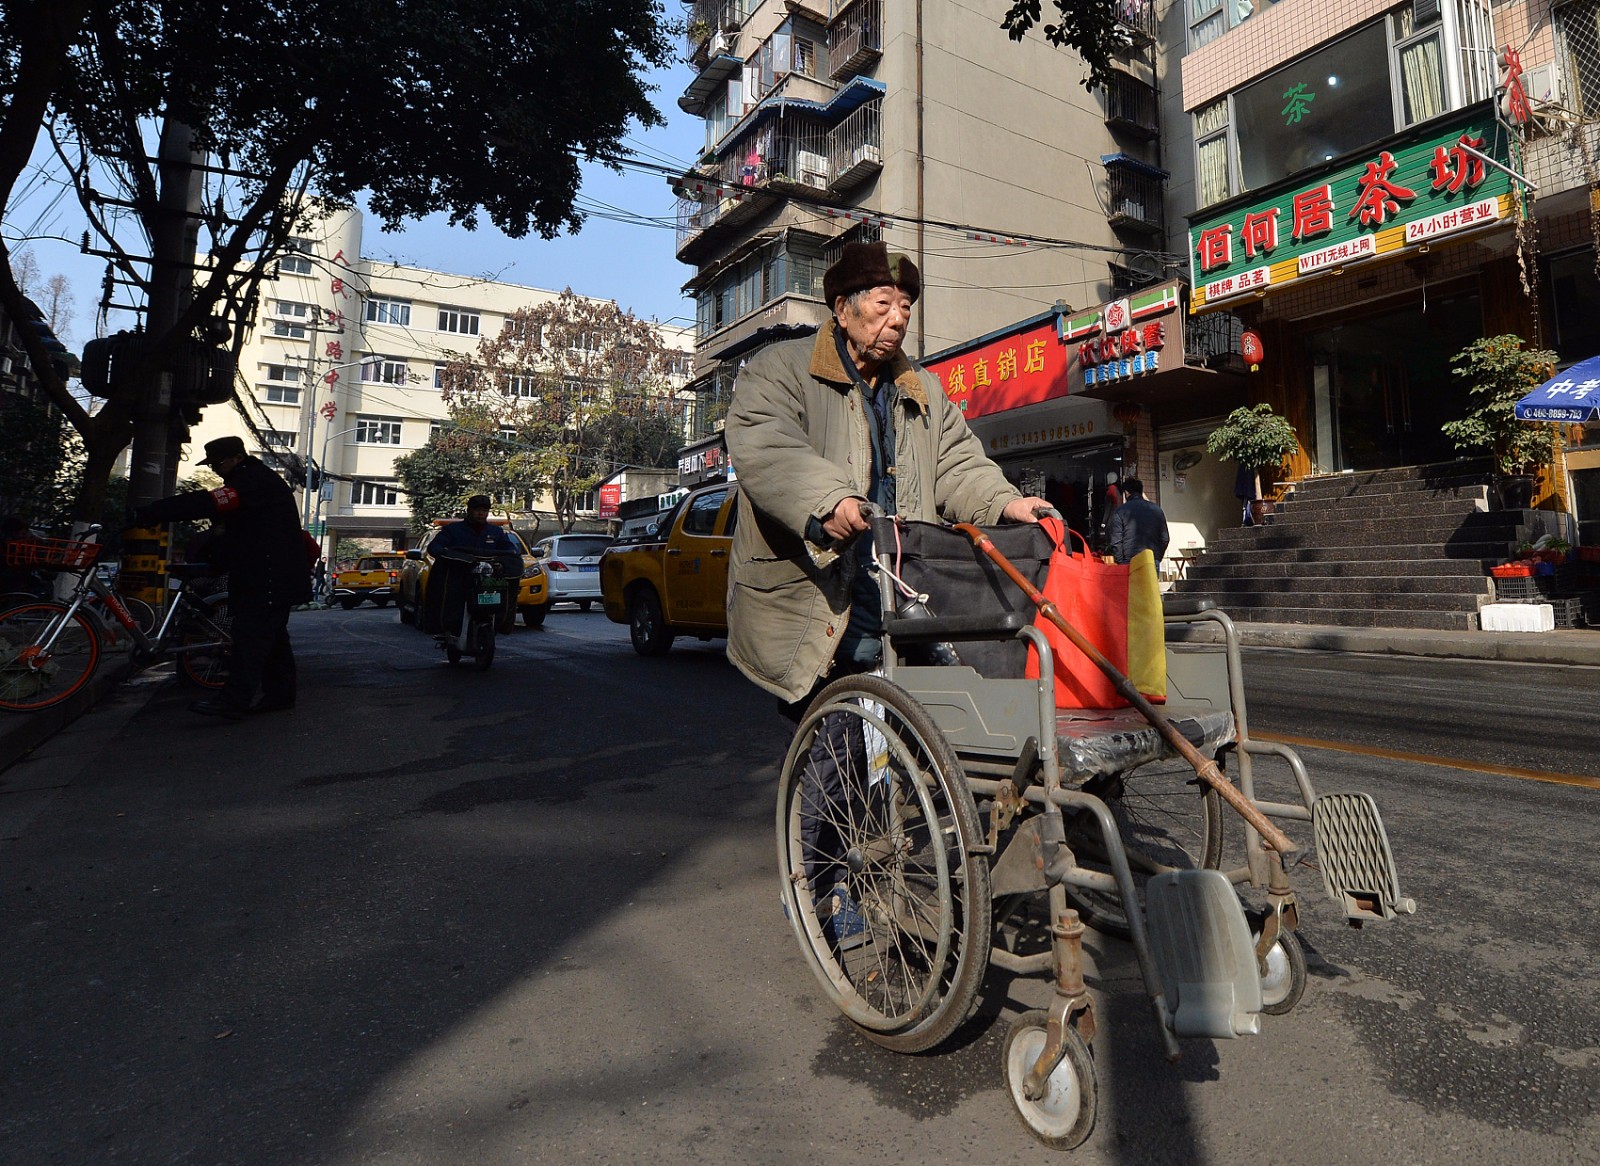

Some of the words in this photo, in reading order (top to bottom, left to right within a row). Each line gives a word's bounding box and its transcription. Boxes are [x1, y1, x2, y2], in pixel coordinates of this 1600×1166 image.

[1281, 82, 1315, 126] 茶
[1196, 134, 1488, 272] 佰何居茶坊
[1409, 203, 1493, 239] 24小时营业
[1299, 237, 1371, 270] WIFI无线上网
[1208, 280, 1234, 299] 棋牌
[1238, 269, 1265, 289] 品茗
[320, 249, 351, 422] 人民北路中学
[938, 338, 1047, 397] 绒直销店
[1546, 378, 1600, 400] 中考
